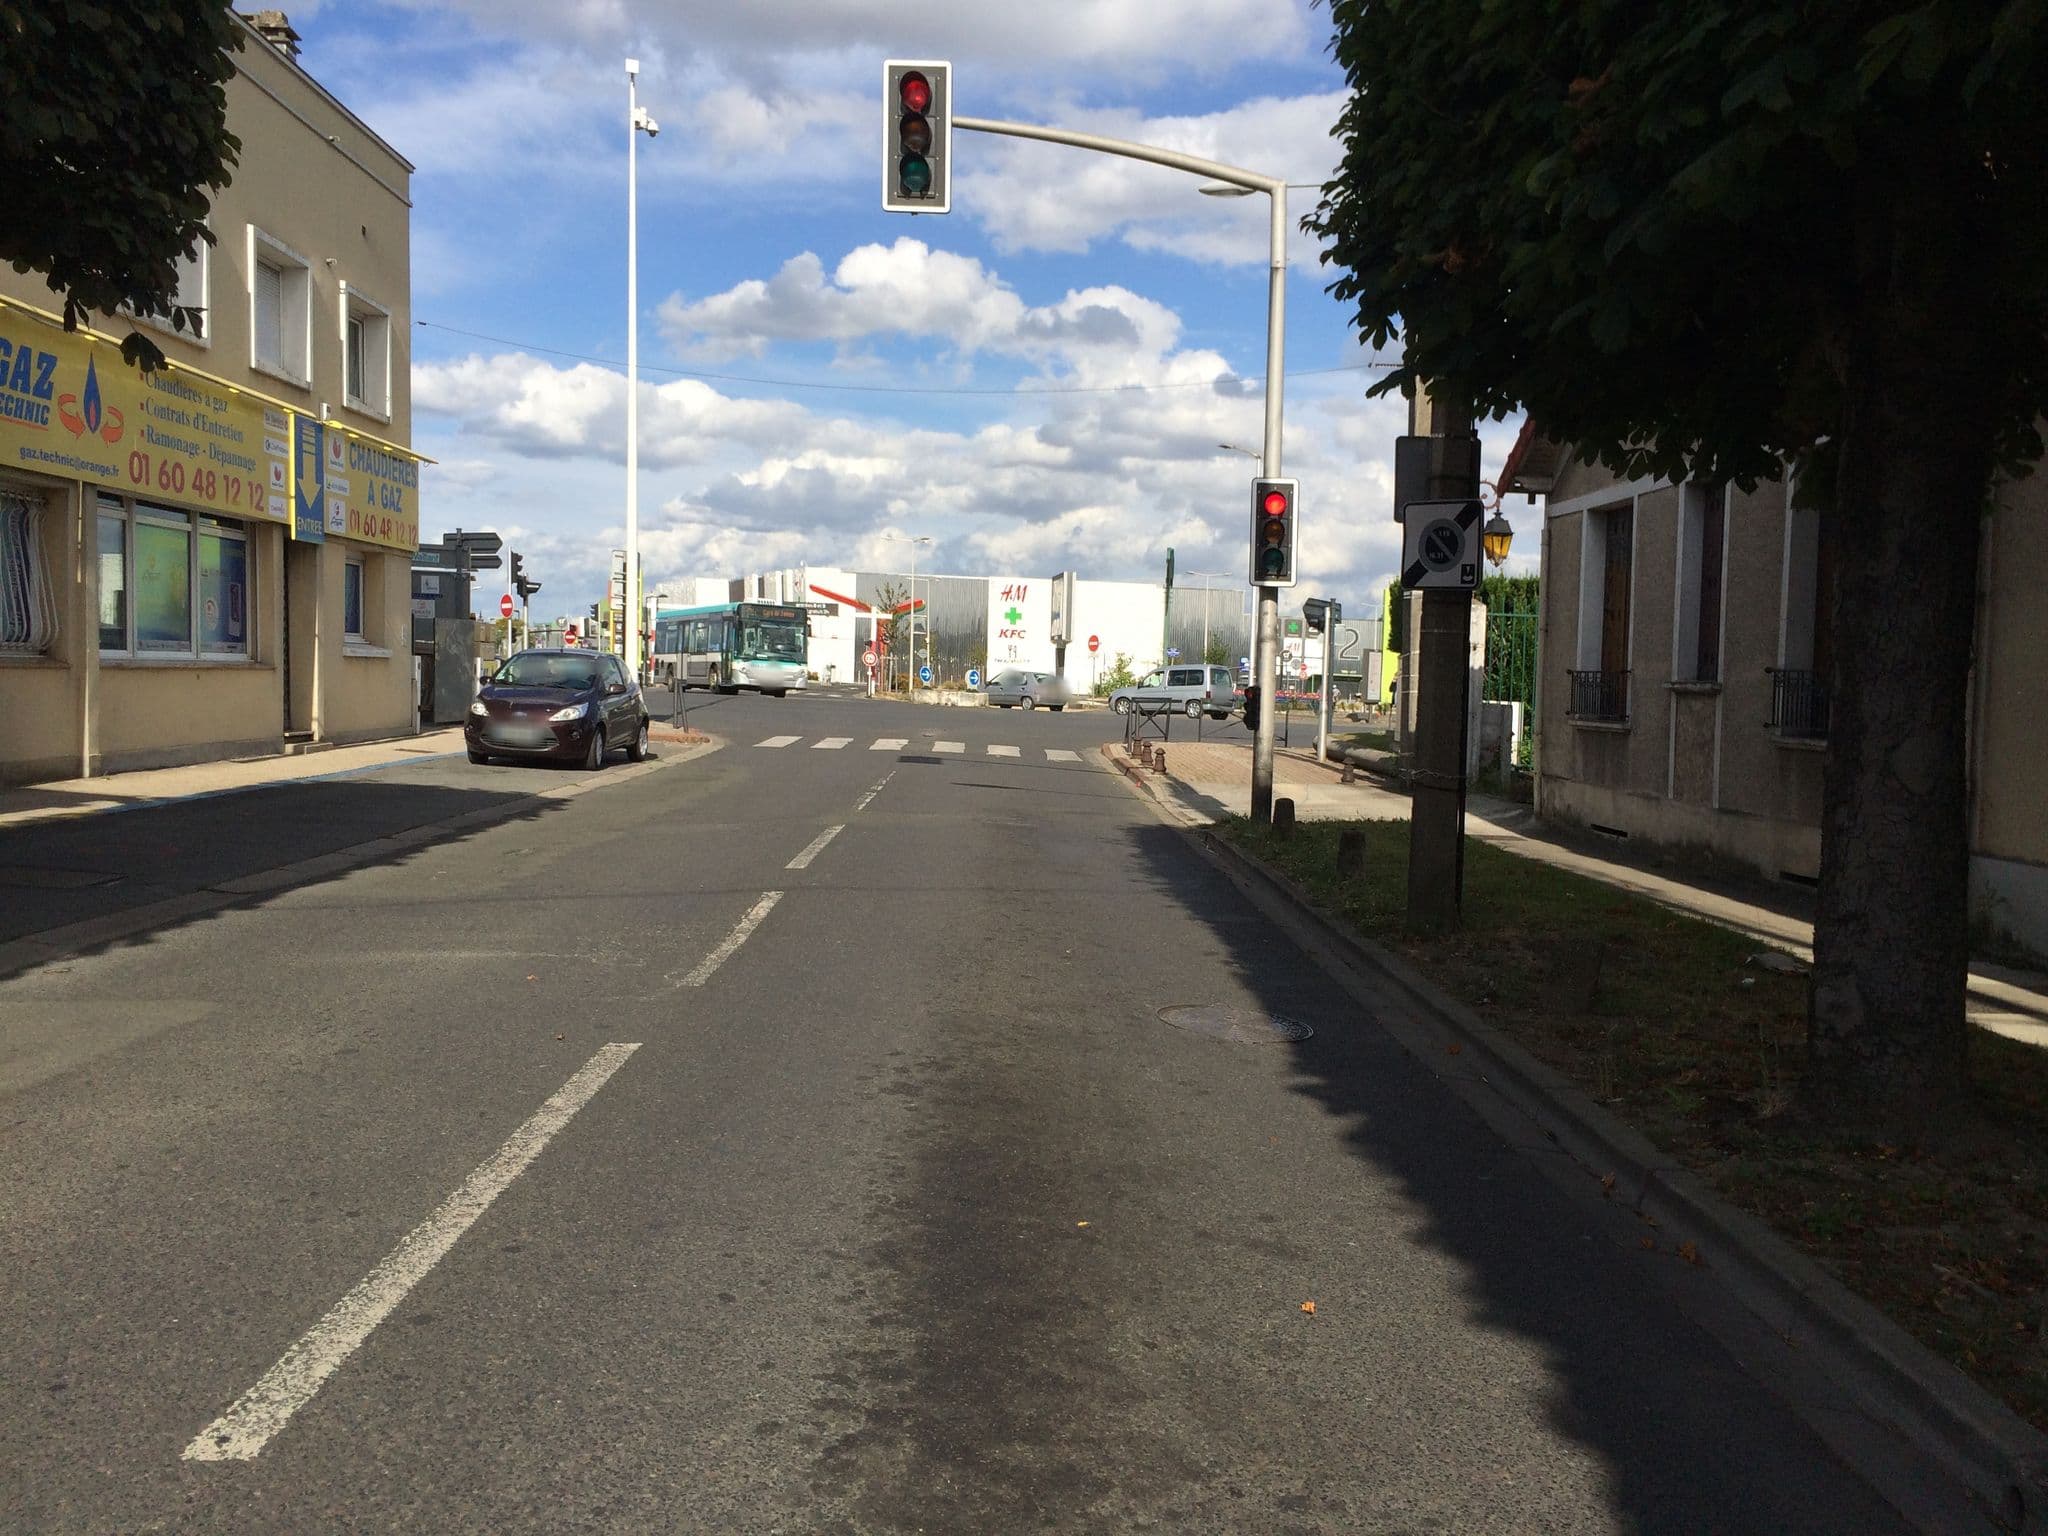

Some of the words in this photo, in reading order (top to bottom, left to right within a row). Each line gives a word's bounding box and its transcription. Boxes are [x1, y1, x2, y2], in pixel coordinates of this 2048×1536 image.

[146, 397, 190, 427] Contrats
[193, 413, 244, 443] d'Entretien
[213, 396, 229, 414] gaz
[147, 424, 200, 459] Ramonage
[20, 446, 119, 477] gaz.technic@orange.fr
[129, 450, 150, 486] 01
[158, 459, 185, 494] 60
[192, 467, 216, 501] 48
[223, 474, 241, 506] 12
[248, 480, 265, 512] 12
[367, 478, 376, 506] A
[381, 482, 402, 514] GAZ
[349, 508, 360, 534] 01
[363, 513, 377, 538] 60
[380, 517, 393, 541] 48
[395, 520, 405, 545] 12
[408, 523, 418, 546] 12
[998, 628, 1027, 640] KFC
[1338, 628, 1360, 661] 2
